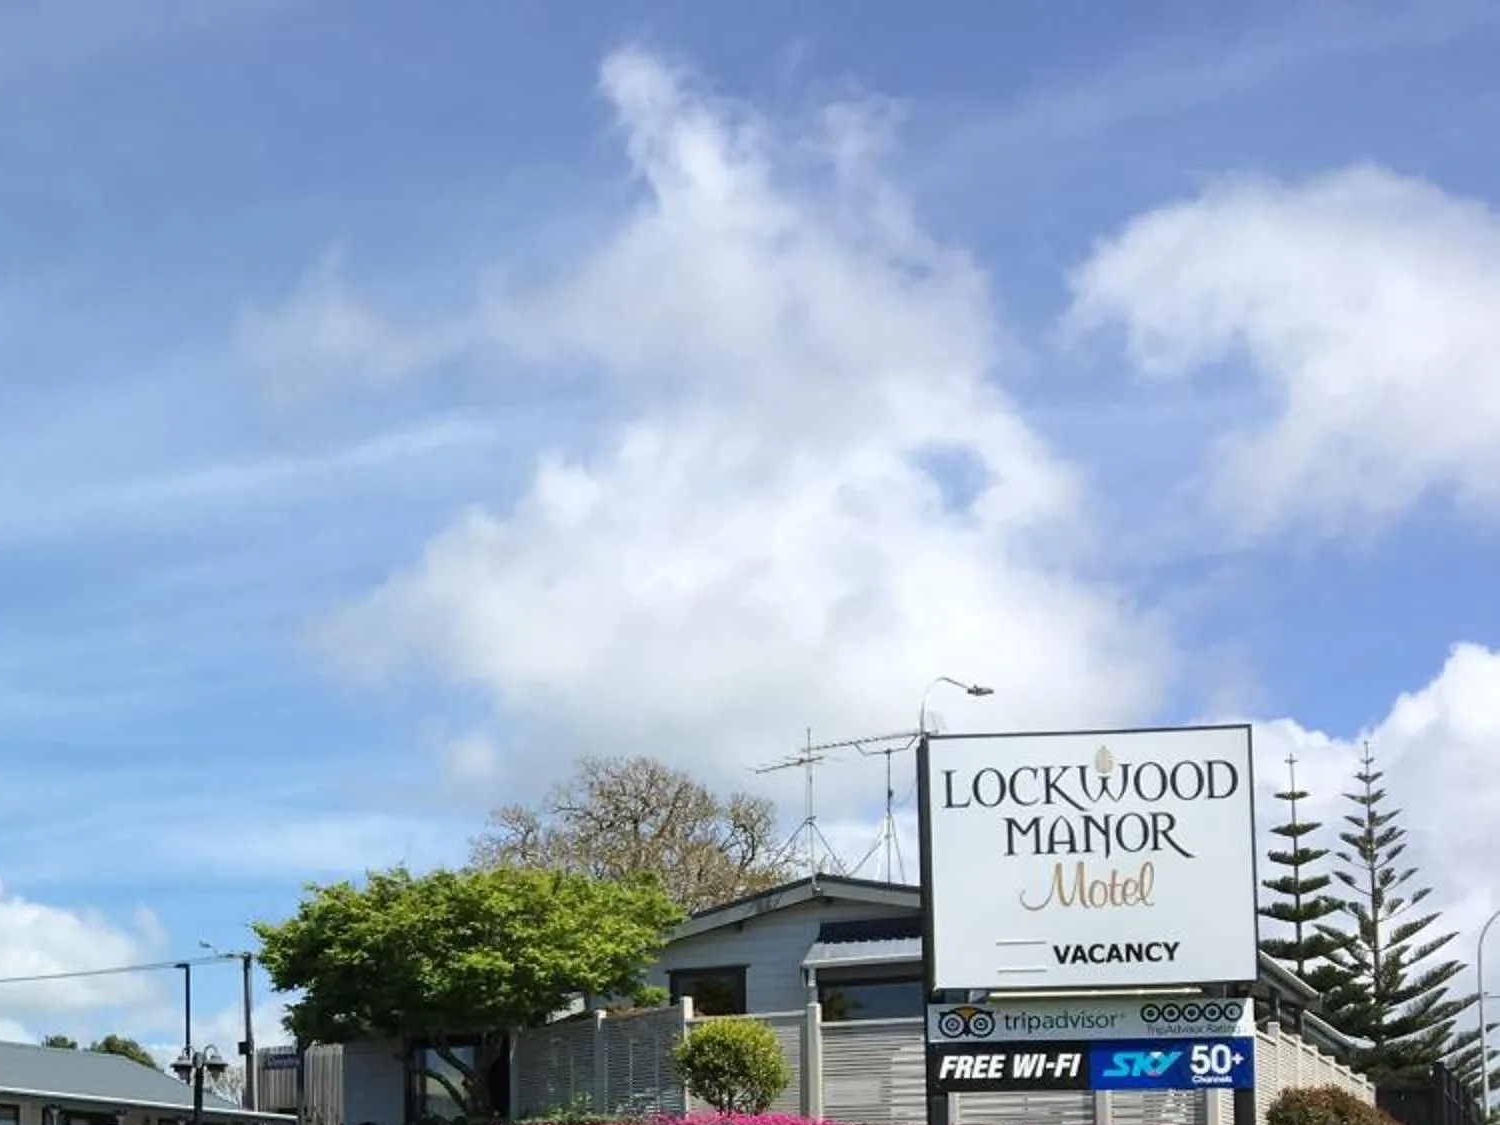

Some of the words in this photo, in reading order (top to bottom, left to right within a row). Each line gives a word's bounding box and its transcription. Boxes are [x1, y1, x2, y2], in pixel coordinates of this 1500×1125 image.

[941, 760, 1239, 812] LOCKWOOD
[1003, 812, 1196, 859] MANOR
[1019, 860, 1156, 911] Motel
[1052, 941, 1181, 965] VACANCY
[1004, 1009, 1118, 1034] tripadvisor
[939, 1053, 1007, 1080] FREE
[1012, 1052, 1082, 1079] WI-FI
